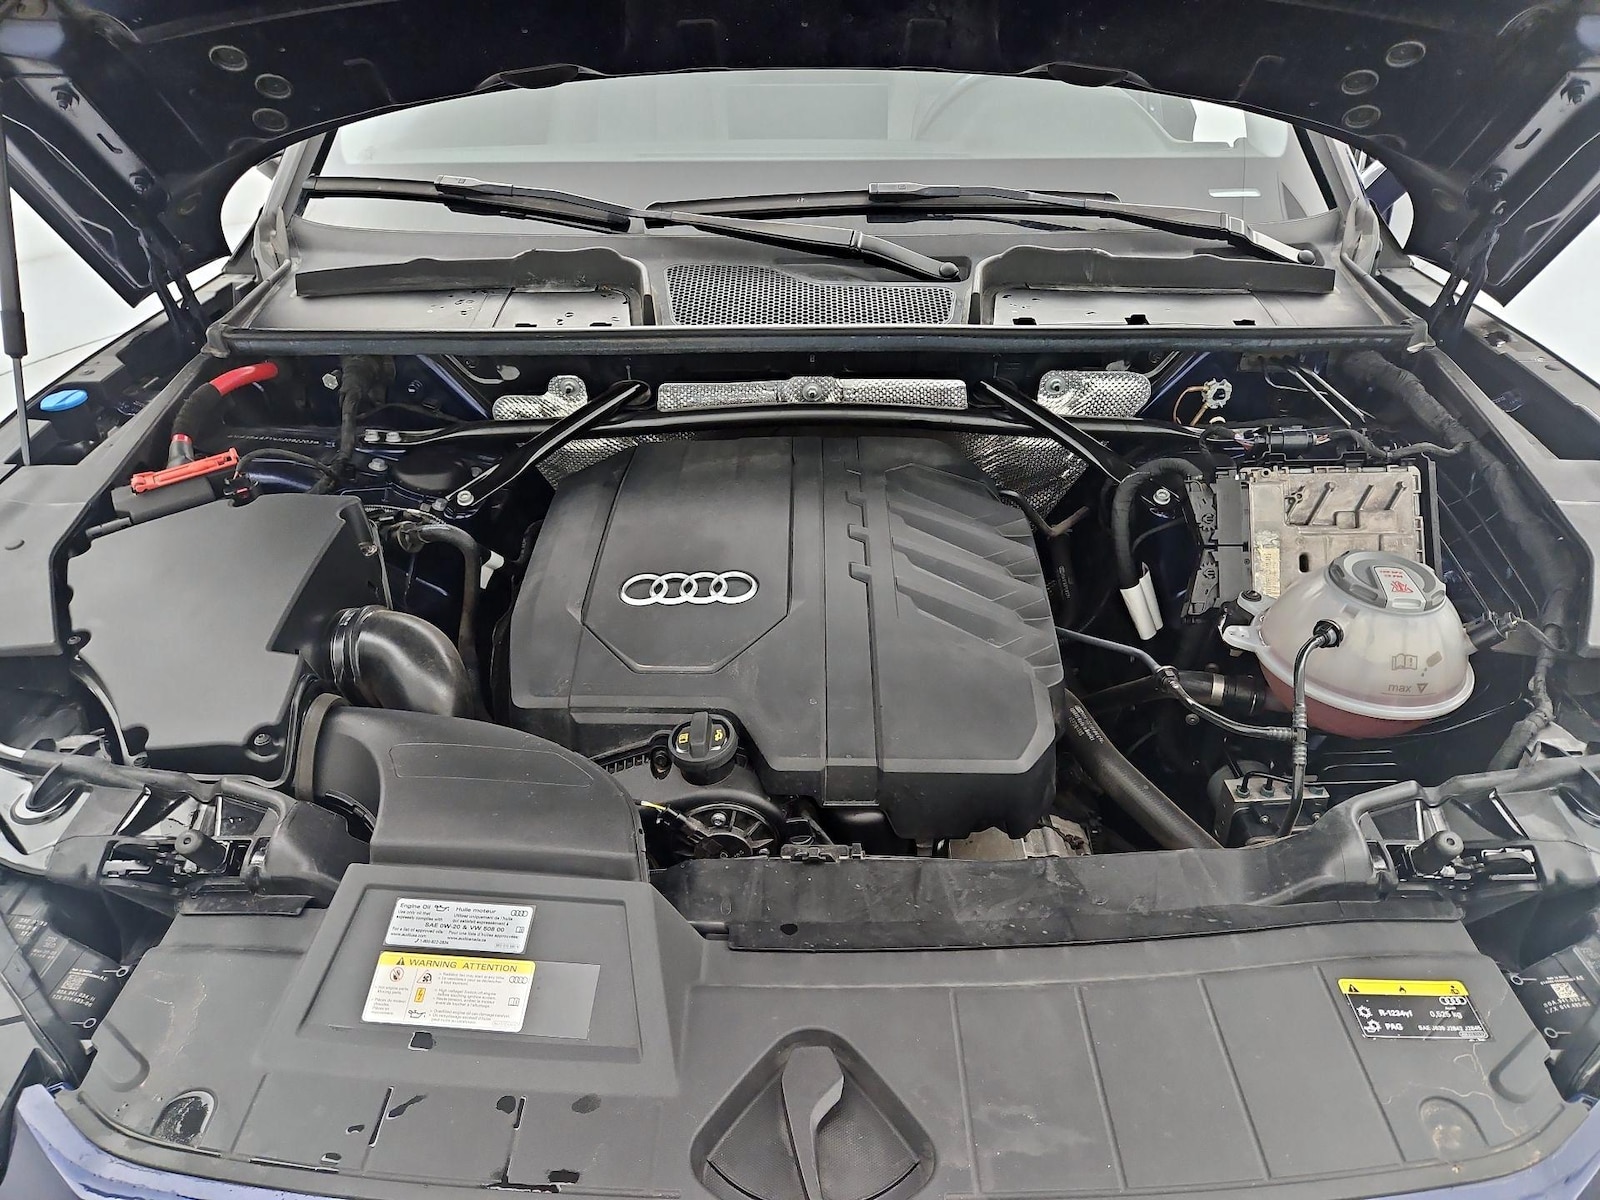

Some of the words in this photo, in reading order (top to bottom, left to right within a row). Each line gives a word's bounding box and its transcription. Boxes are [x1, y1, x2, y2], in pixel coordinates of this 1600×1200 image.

[1388, 683, 1411, 692] max
[409, 958, 456, 968] WARNING
[462, 962, 517, 972] ATTENTION
[1379, 1009, 1412, 1017] R-1234yf
[1385, 1022, 1403, 1030] PAG
